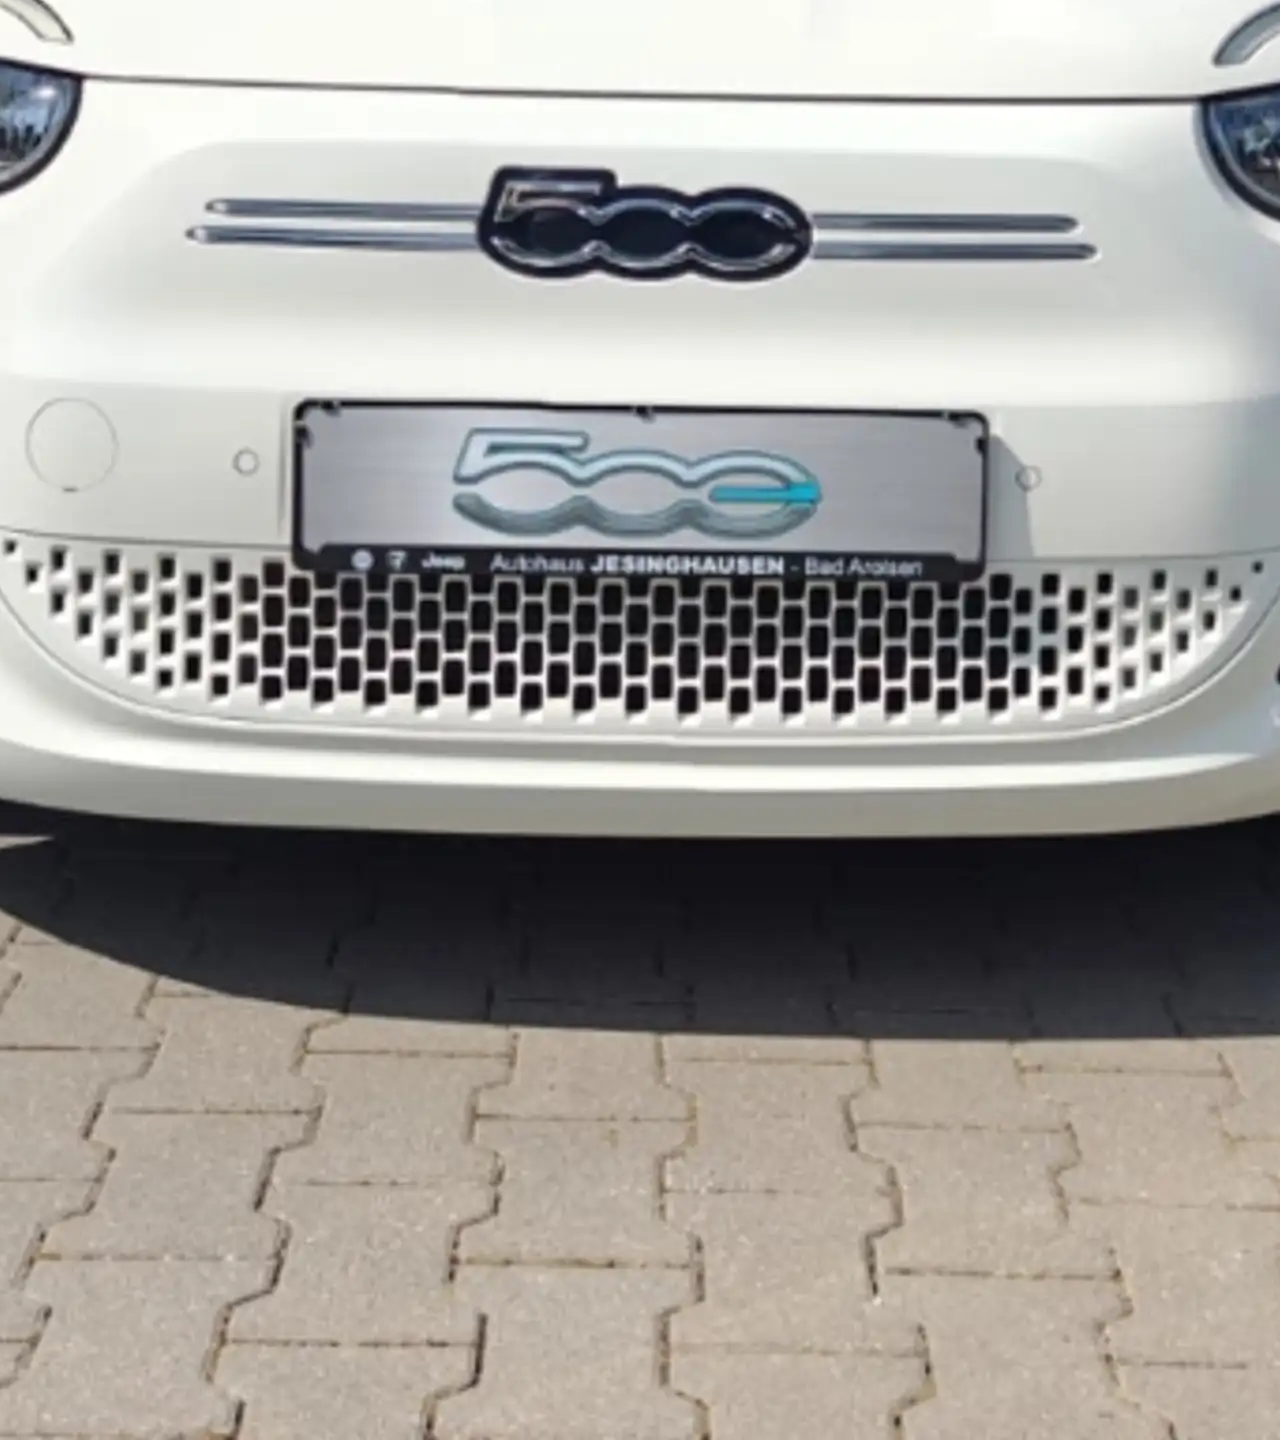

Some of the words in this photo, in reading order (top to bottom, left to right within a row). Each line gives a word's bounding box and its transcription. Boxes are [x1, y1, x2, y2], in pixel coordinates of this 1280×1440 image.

[478, 166, 811, 281] 500
[490, 551, 585, 573] Autohaus
[590, 553, 784, 575] JESINGHAUSEN
[804, 556, 842, 575] Bad
